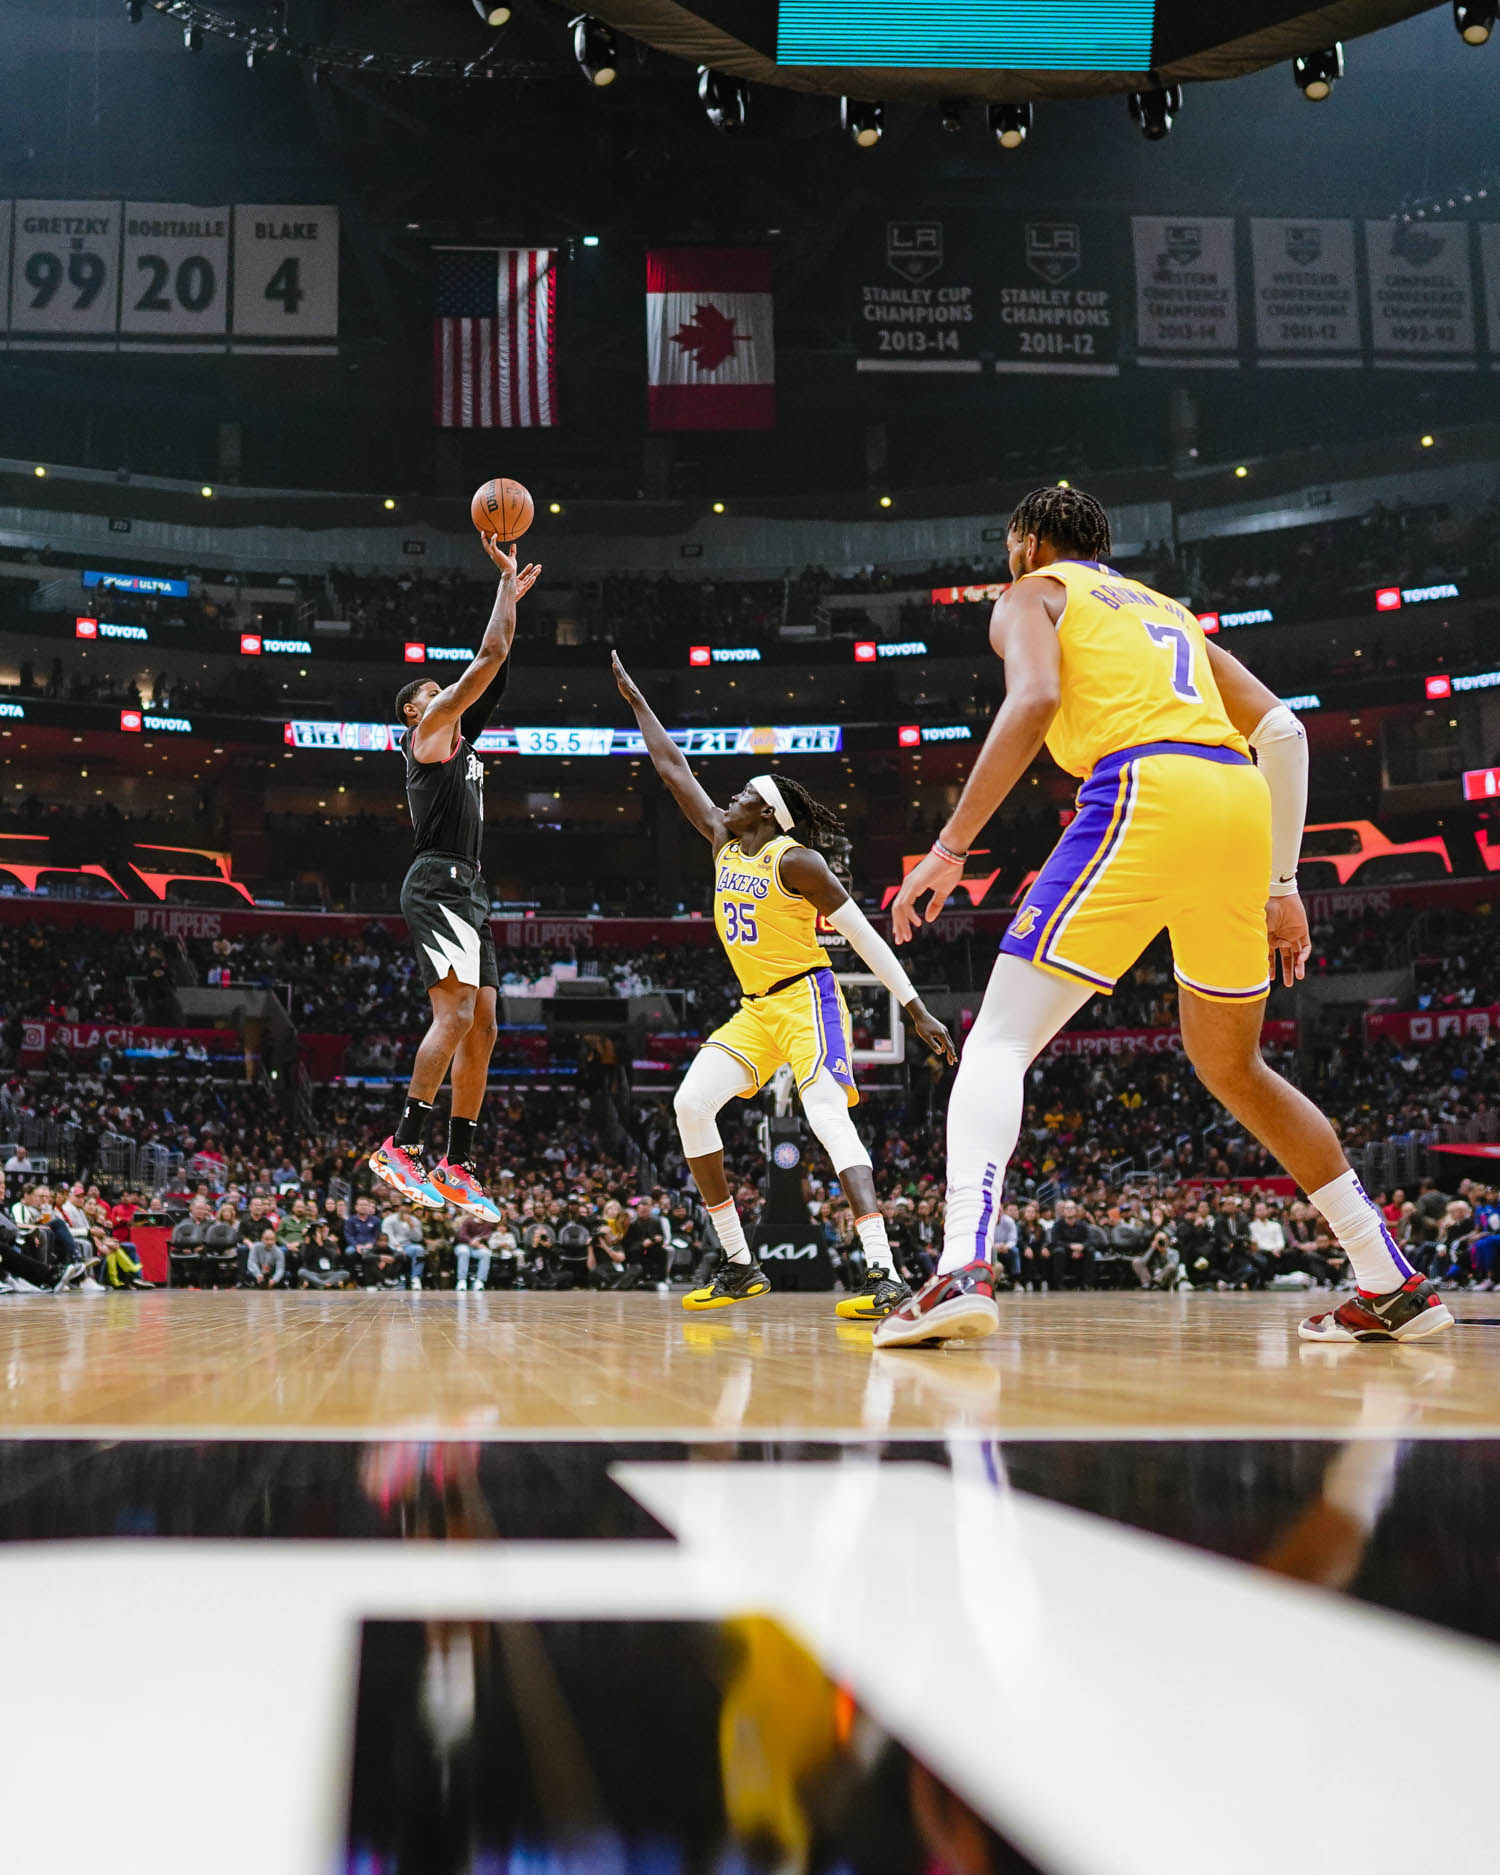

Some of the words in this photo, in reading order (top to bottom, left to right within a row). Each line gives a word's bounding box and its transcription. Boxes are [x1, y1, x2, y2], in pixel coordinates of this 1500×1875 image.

[23, 217, 109, 236] GRETZKY
[127, 220, 225, 238] ROBITAILLE
[254, 222, 319, 240] BLAKE
[24, 250, 107, 310] 99
[133, 253, 217, 314] 20
[264, 256, 305, 315] 4
[862, 287, 931, 304] STANLEY
[936, 287, 973, 303] CUP
[1000, 289, 1070, 306] STANLEY
[1075, 291, 1110, 306] CUP
[863, 304, 974, 322] CHAMPIONS
[1001, 307, 1110, 326] CHAMPIONS
[878, 330, 960, 351] 2013-14
[1018, 331, 1095, 354] 2011-12
[139, 581, 172, 592] ULTRA
[1401, 584, 1458, 603] TOYOTA
[1220, 610, 1272, 628] TOYOTA
[99, 624, 148, 640] TOYOTA
[263, 640, 311, 653] TOYOTA
[427, 648, 475, 661] TOYOTA
[712, 649, 761, 662] TOYOTA
[877, 642, 927, 656] TOYOTA
[1141, 619, 1205, 705] 7
[144, 716, 192, 732] TOYOTA
[529, 732, 582, 752] 35.5
[700, 733, 727, 750] 21
[921, 726, 972, 742] TOYOTA
[600, 738, 606, 752] 1
[716, 866, 771, 899] LAKERS
[722, 901, 760, 946] 35
[759, 1244, 818, 1260] KIA
